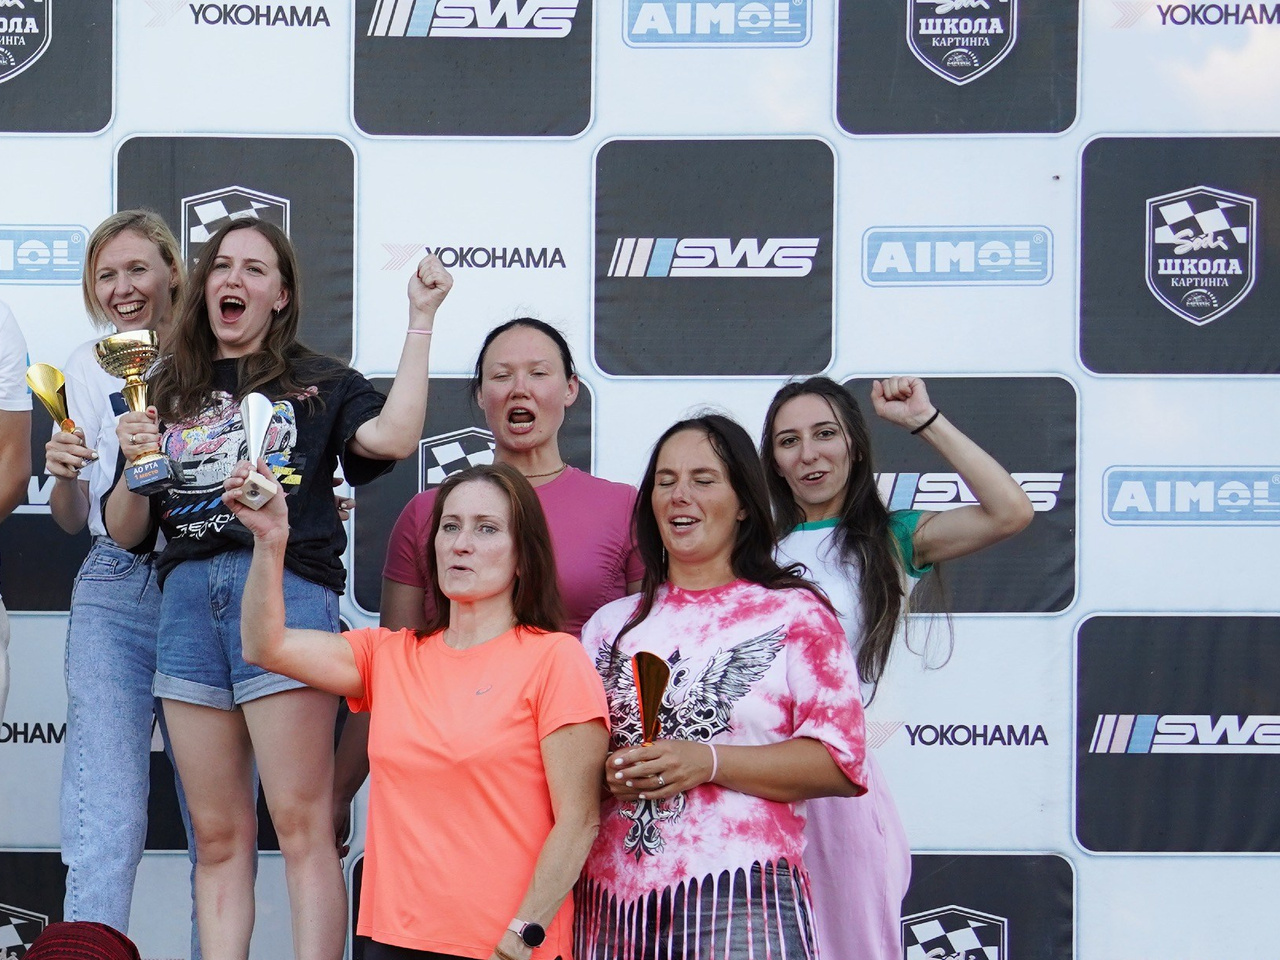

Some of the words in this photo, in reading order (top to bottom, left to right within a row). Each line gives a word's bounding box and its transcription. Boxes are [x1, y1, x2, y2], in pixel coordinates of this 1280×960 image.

[189, 4, 331, 27] YOKOHAMA
[429, 0, 577, 38] SWS
[631, 2, 801, 34] AIMOL
[919, 18, 1004, 35] ШКОЛА
[932, 36, 990, 47] КАРТИНГА
[669, 237, 821, 278] SWS
[871, 241, 1043, 274] AIMOL
[1157, 258, 1243, 275] ШКОЛА
[1170, 277, 1229, 287] КАРТИНГА
[1111, 480, 1280, 514] AIMOL
[905, 723, 1049, 747] YOKOHAMA
